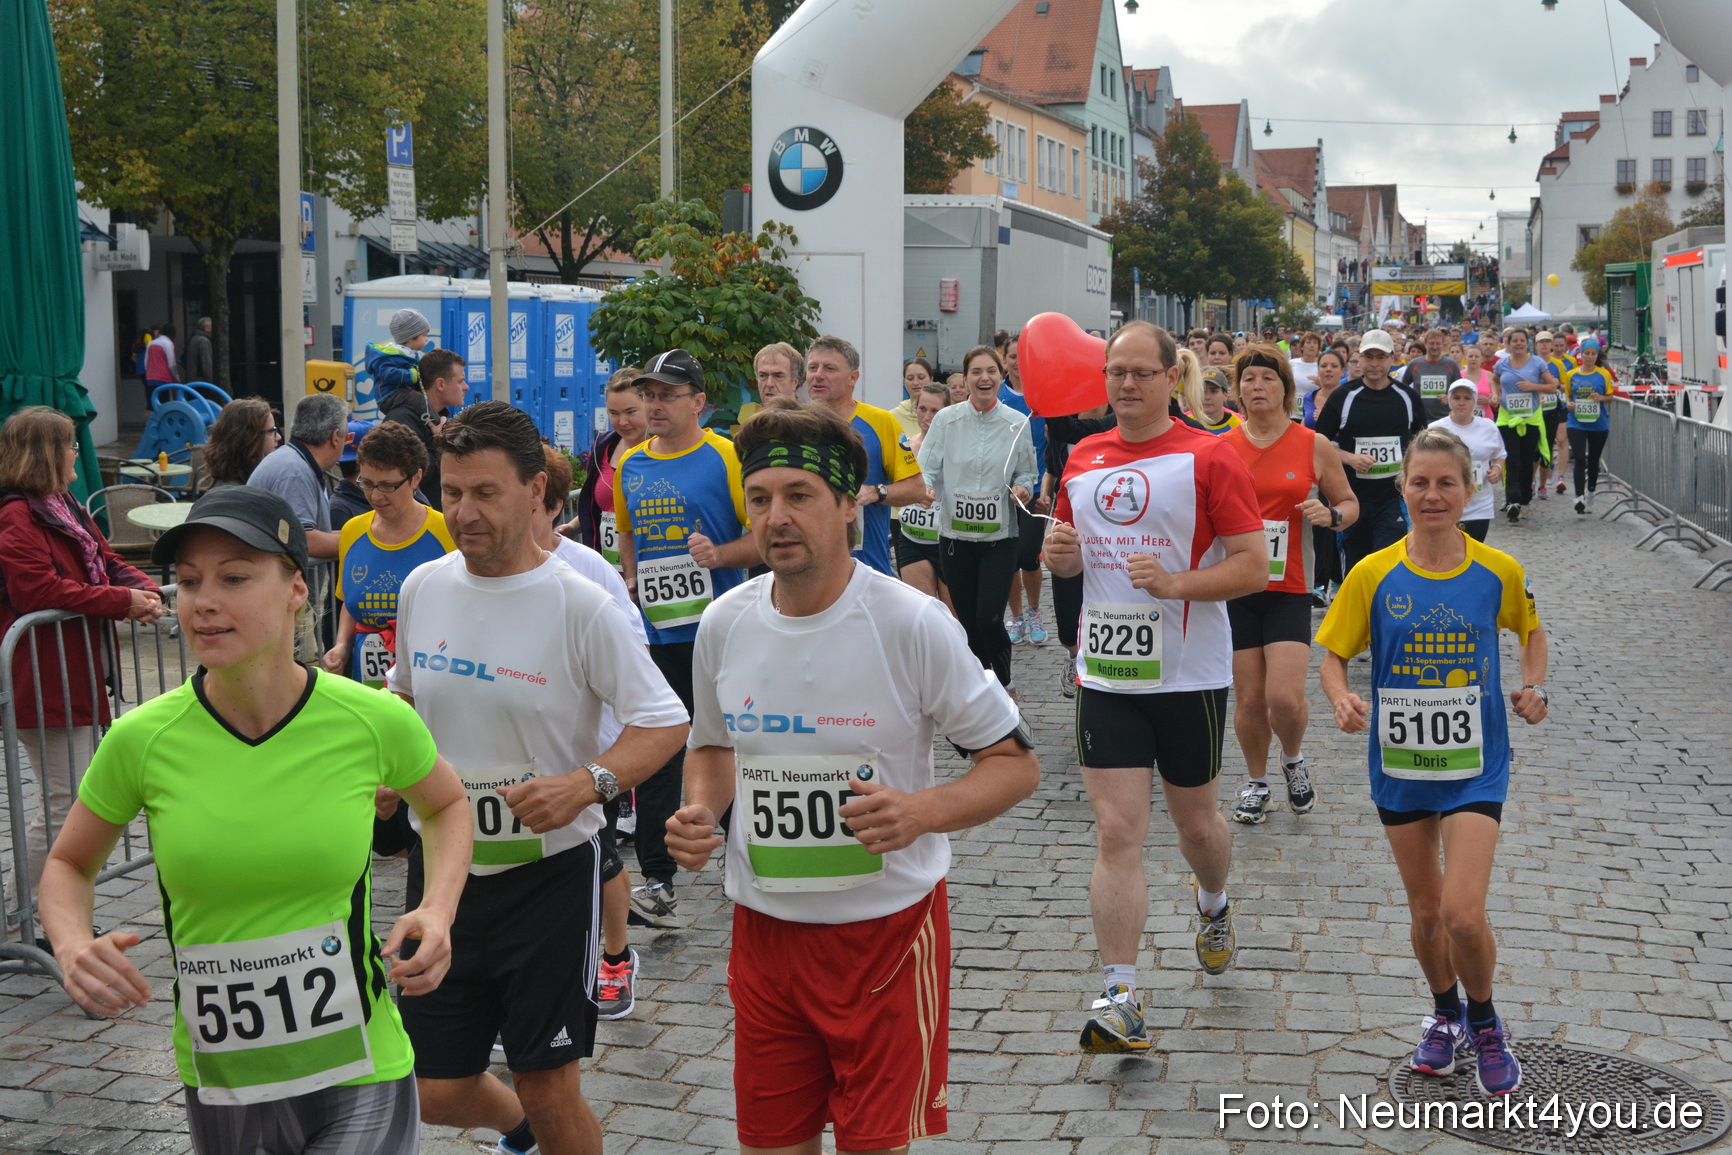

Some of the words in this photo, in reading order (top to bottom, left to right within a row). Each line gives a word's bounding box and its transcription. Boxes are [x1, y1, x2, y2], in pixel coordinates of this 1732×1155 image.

[773, 128, 838, 157] BMW
[335, 276, 343, 295] 3
[1401, 283, 1435, 293] START
[1423, 381, 1445, 390] 5019
[1508, 398, 1530, 409] 5027
[1576, 404, 1598, 414] 5538
[901, 508, 935, 528] 5051
[955, 500, 997, 521] 5090
[964, 523, 984, 533] Tanja
[659, 561, 695, 573] Neumarkt
[644, 570, 705, 604] 5536
[1103, 611, 1146, 621] Neumarkt
[1088, 623, 1154, 657] 5229
[1404, 656, 1457, 665] 21.September
[1097, 662, 1139, 677] Andreas
[1380, 696, 1411, 707] PARTL
[1413, 697, 1462, 707] Neumarkt
[1388, 709, 1472, 745] 5103
[1413, 753, 1448, 768] Doris
[742, 767, 779, 783] PARTL
[782, 769, 851, 783] Neumarkt
[461, 778, 517, 790] eumarkt
[180, 959, 227, 975] PARTL
[230, 945, 316, 974] Neumarkt
[196, 966, 344, 1044] 5512
[550, 1037, 573, 1048] adidas
